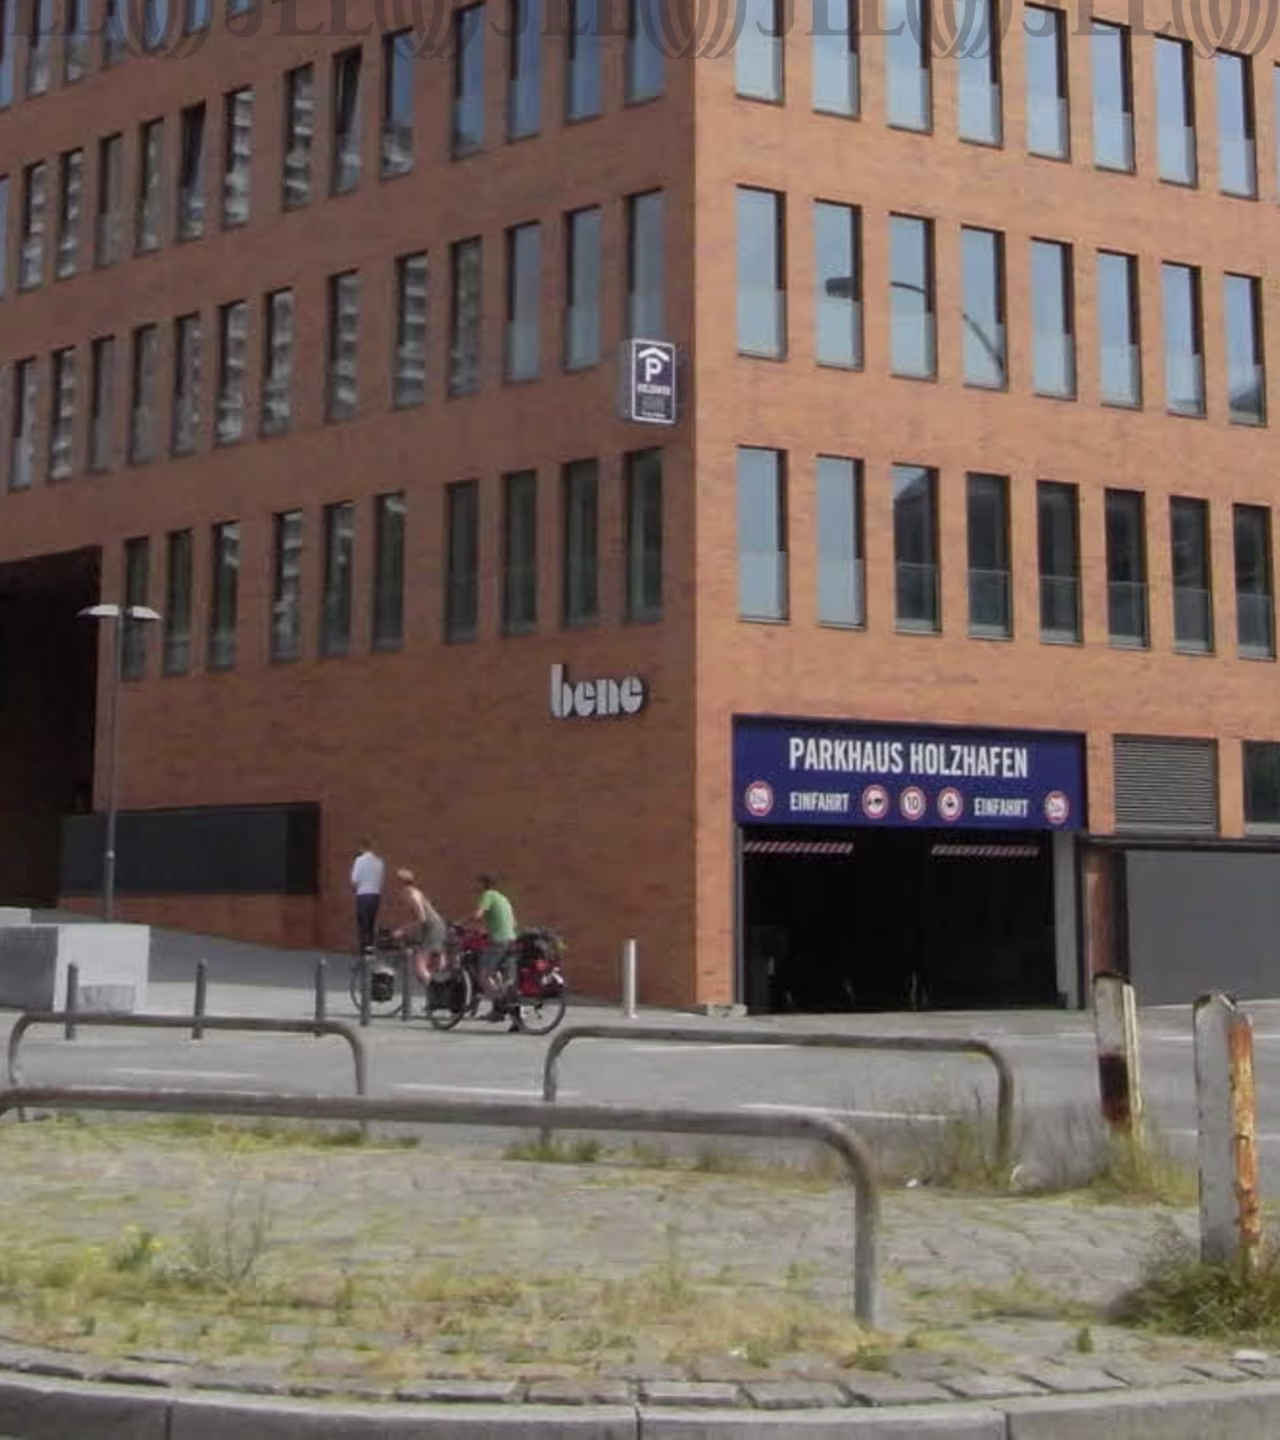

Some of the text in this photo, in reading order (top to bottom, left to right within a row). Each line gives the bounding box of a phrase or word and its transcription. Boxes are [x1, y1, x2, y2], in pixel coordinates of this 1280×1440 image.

[646, 357, 662, 382] P
[551, 663, 643, 717] bene
[789, 737, 1028, 778] PARKHAUS HOLZHAFEN
[789, 791, 850, 812] EINFAHRT
[906, 795, 920, 811] 10
[974, 797, 1029, 817] EINFAHRT
